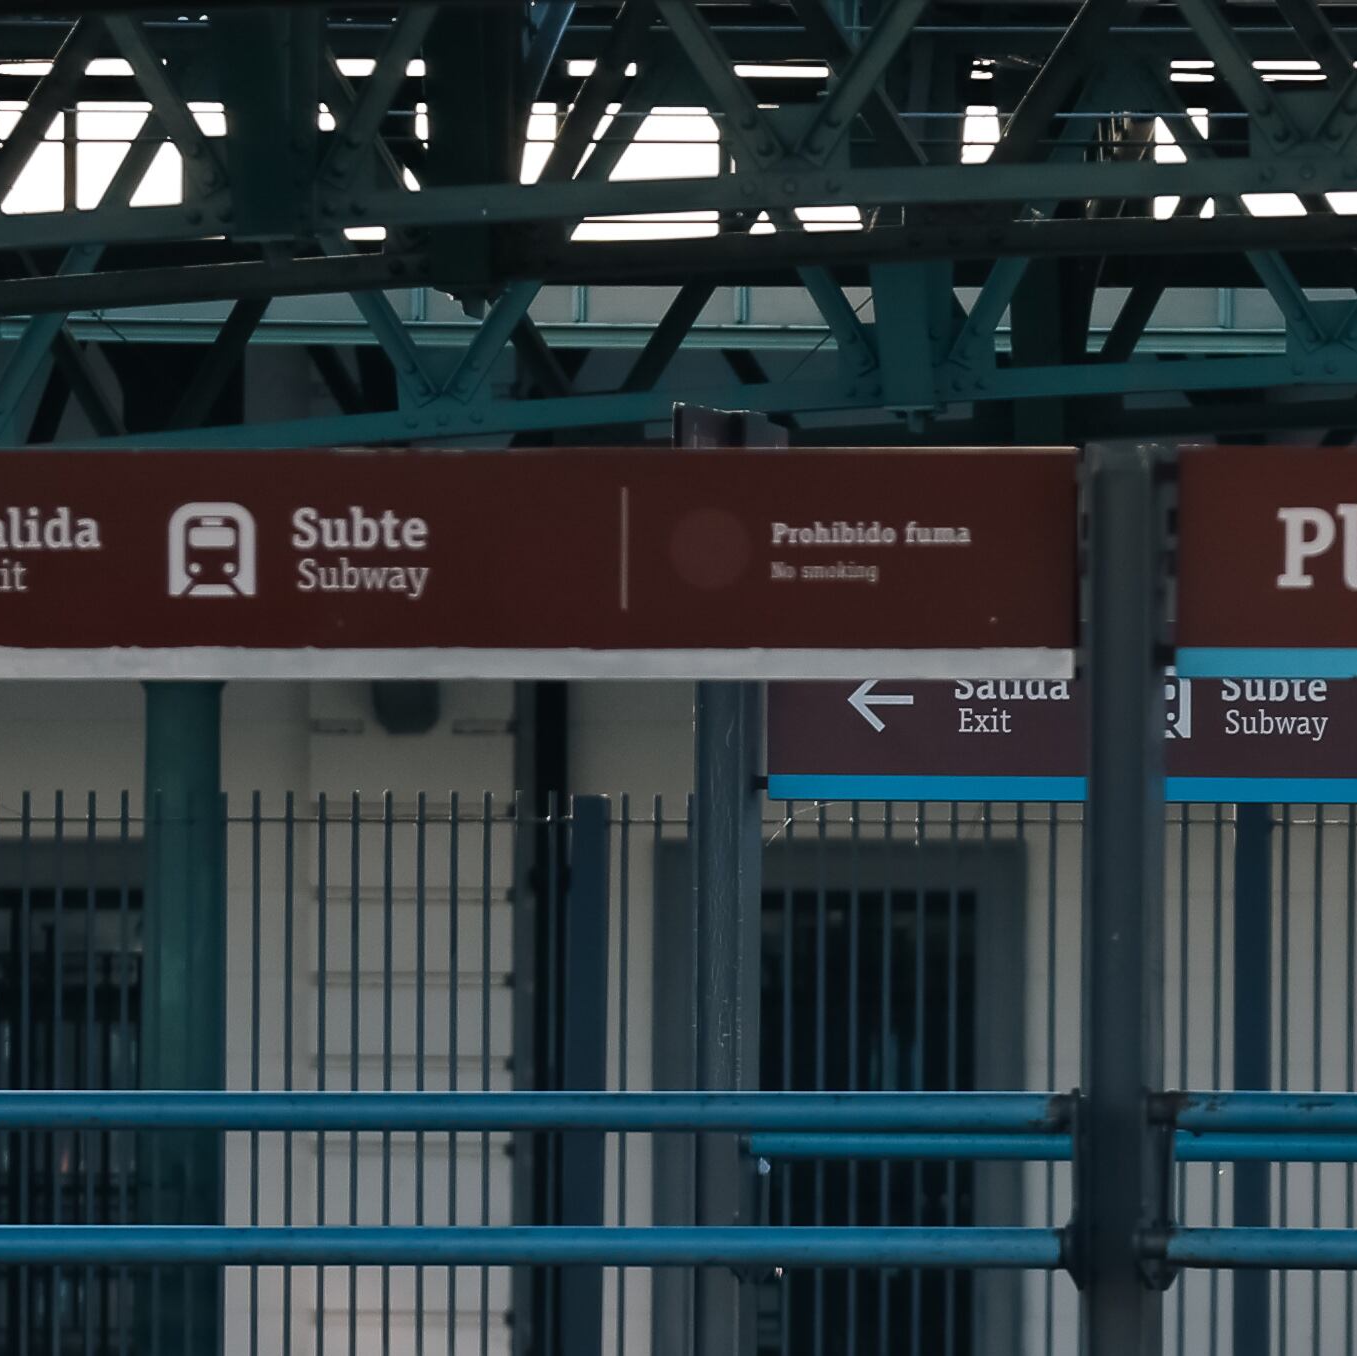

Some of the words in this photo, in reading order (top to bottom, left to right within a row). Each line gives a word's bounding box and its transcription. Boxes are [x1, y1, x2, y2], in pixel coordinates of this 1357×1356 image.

[292, 506, 428, 549] Subte
[771, 521, 897, 545] Prohibido
[904, 521, 972, 545] fuma
[297, 556, 429, 598] Subway
[771, 561, 795, 579] No
[801, 561, 879, 583] smoking
[958, 707, 1012, 733] Exit
[1225, 708, 1329, 742] Subway
